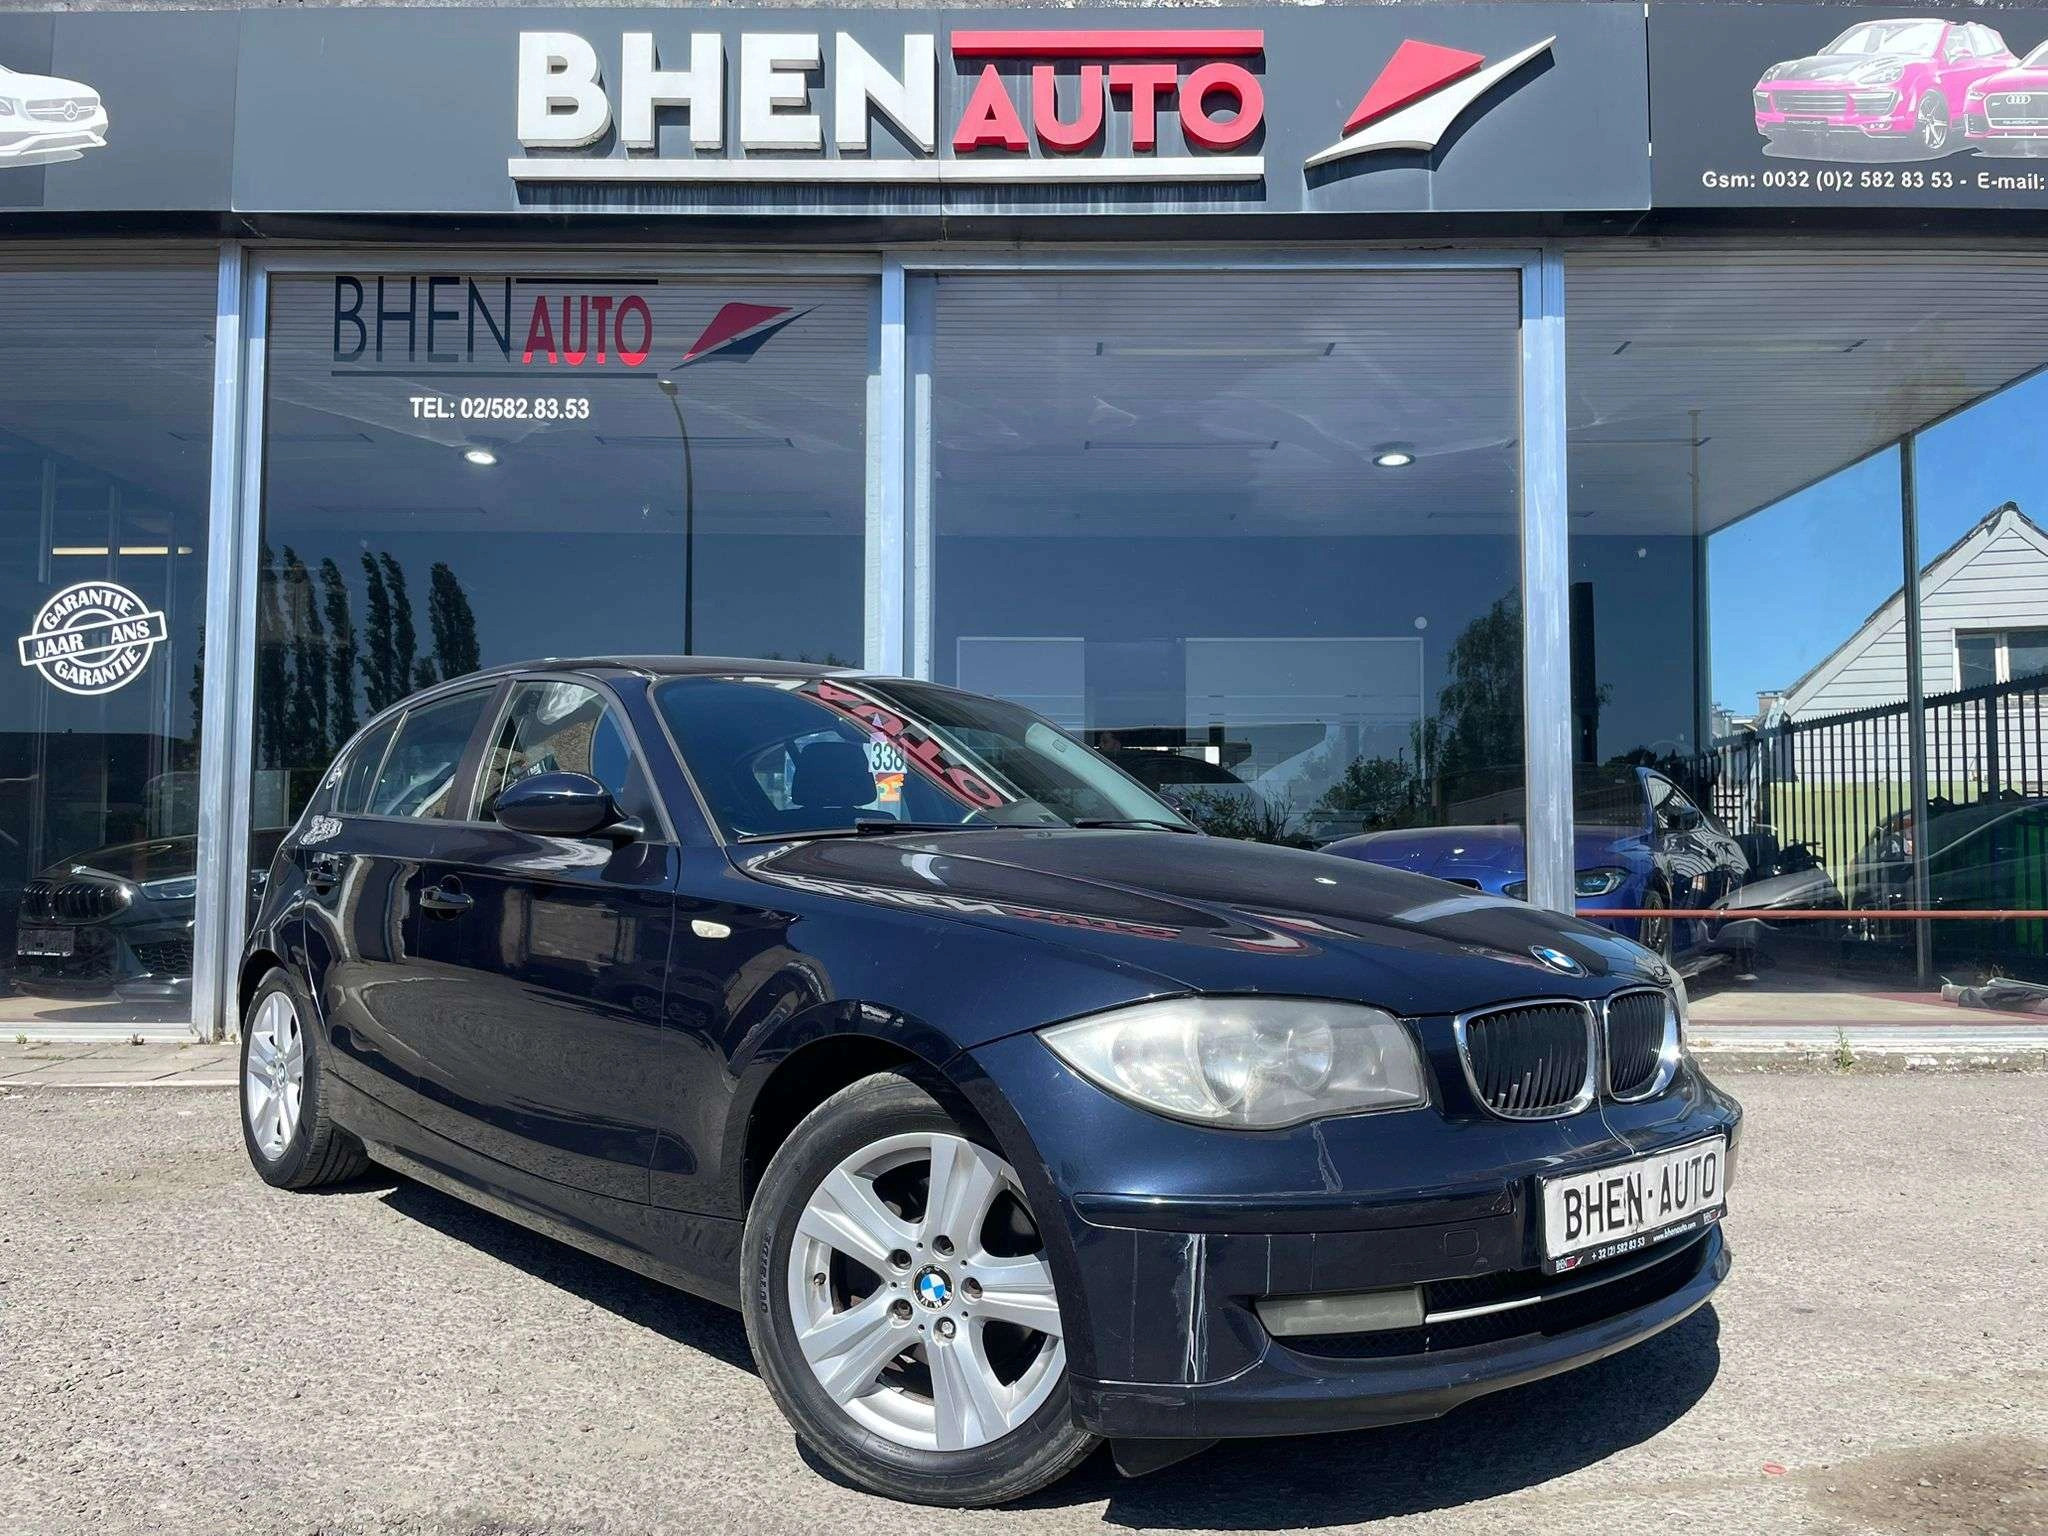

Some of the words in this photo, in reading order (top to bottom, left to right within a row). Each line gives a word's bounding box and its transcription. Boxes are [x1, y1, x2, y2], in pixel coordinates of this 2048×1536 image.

[518, 32, 935, 151] BHEN
[952, 62, 1265, 153] AUTO
[1702, 171, 1756, 188] Gsm:
[1763, 171, 1810, 188] 0032
[1816, 170, 1853, 191] (0)2
[1860, 171, 1895, 188] 582
[1901, 171, 1924, 188] 83
[1931, 171, 1953, 188] 53
[1977, 172, 2046, 190] E-mail:
[333, 276, 511, 363] BHEN
[521, 295, 653, 366] AUTO
[410, 397, 455, 419] TEL:
[460, 397, 590, 419] 02/582.83.53
[42, 589, 134, 630] GARANTIE
[35, 633, 85, 659] JAAR
[110, 620, 150, 644] ANS
[54, 645, 141, 686] GARANTIE
